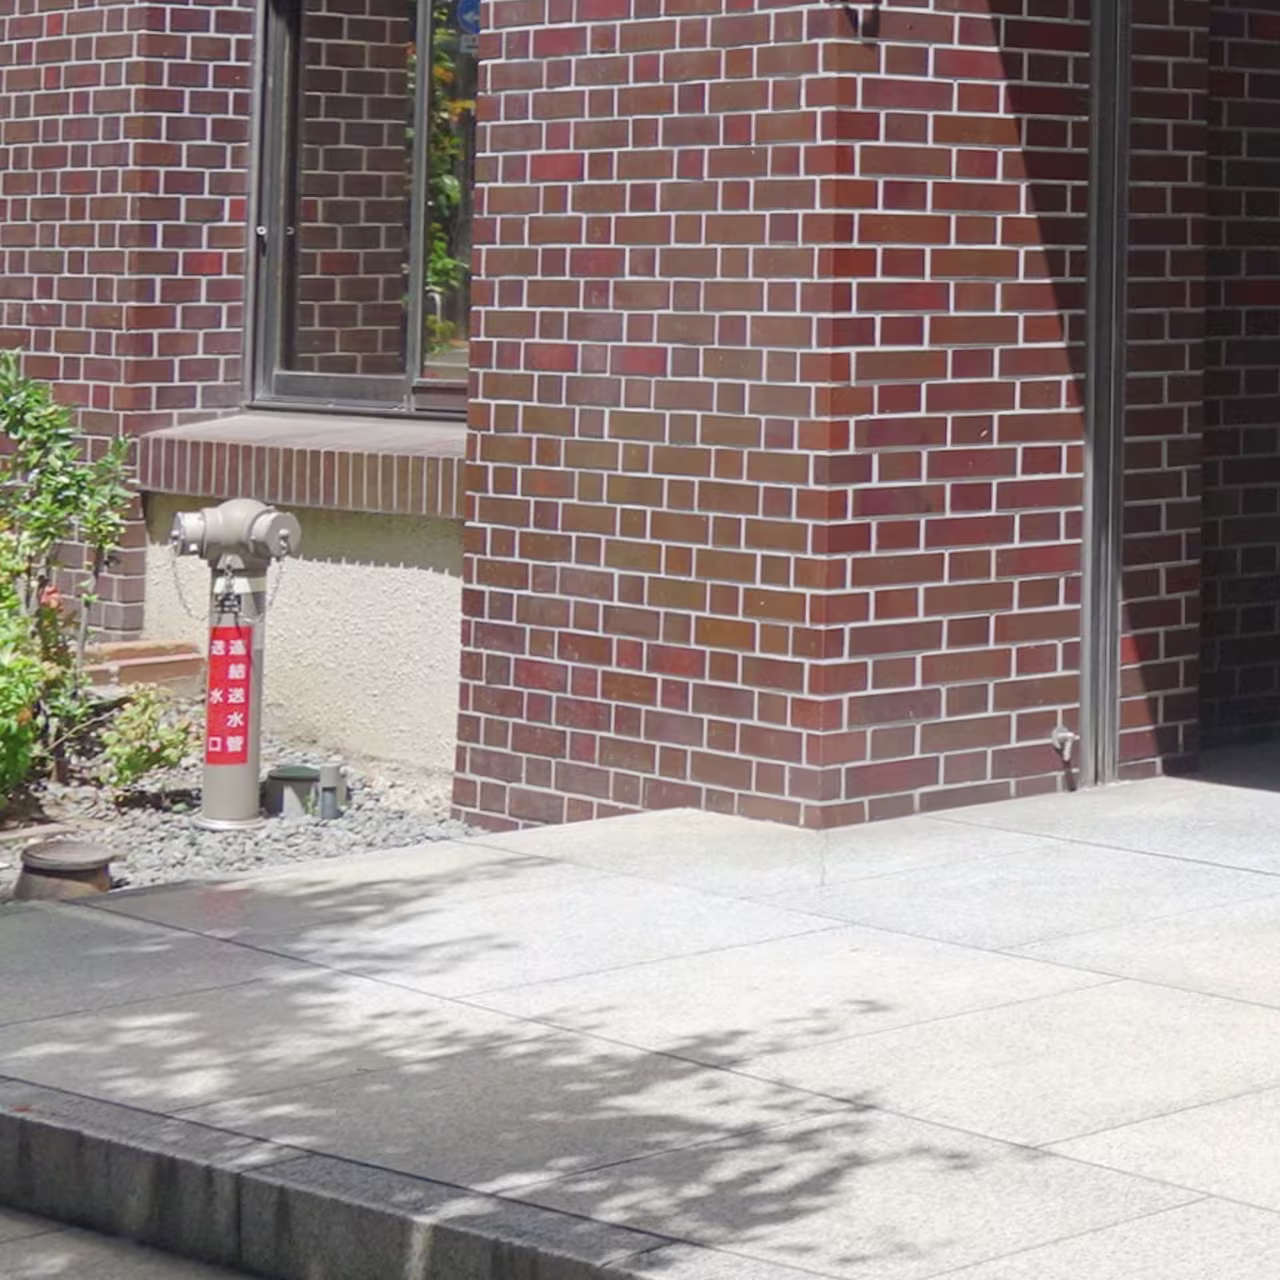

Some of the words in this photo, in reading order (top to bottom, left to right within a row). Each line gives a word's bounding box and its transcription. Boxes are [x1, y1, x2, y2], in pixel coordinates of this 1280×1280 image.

[208, 639, 226, 752] 送水口
[226, 639, 247, 754] 連結送水管
